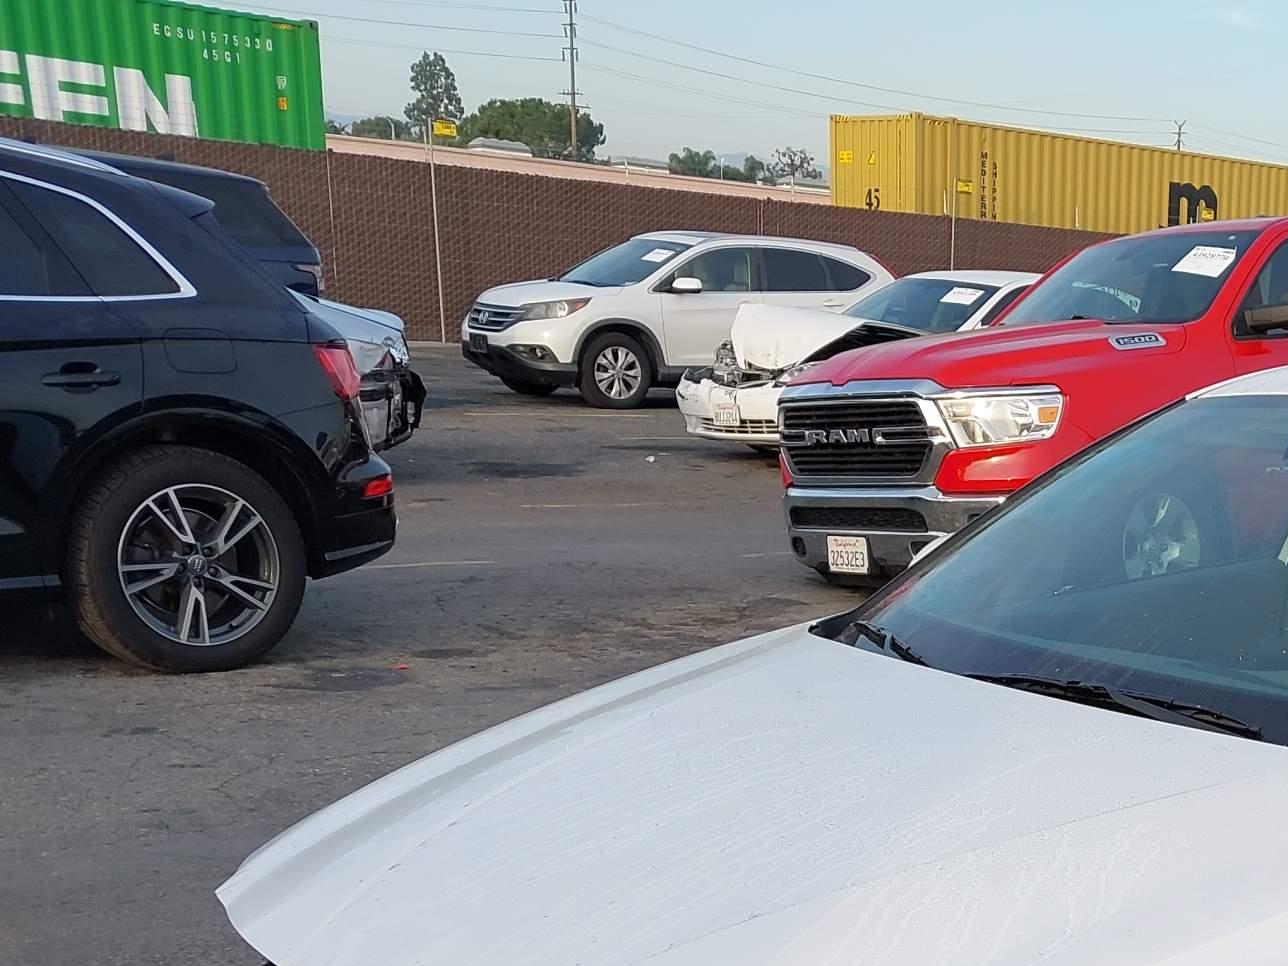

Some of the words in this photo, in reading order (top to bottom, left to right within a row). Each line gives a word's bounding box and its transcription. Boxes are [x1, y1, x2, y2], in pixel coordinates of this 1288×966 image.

[153, 23, 194, 40] EGSU
[203, 48, 240, 64] 45G1
[865, 188, 880, 209] 45
[1117, 335, 1157, 345] 1500
[807, 429, 870, 443] RAM
[830, 550, 865, 568] 32532E3
